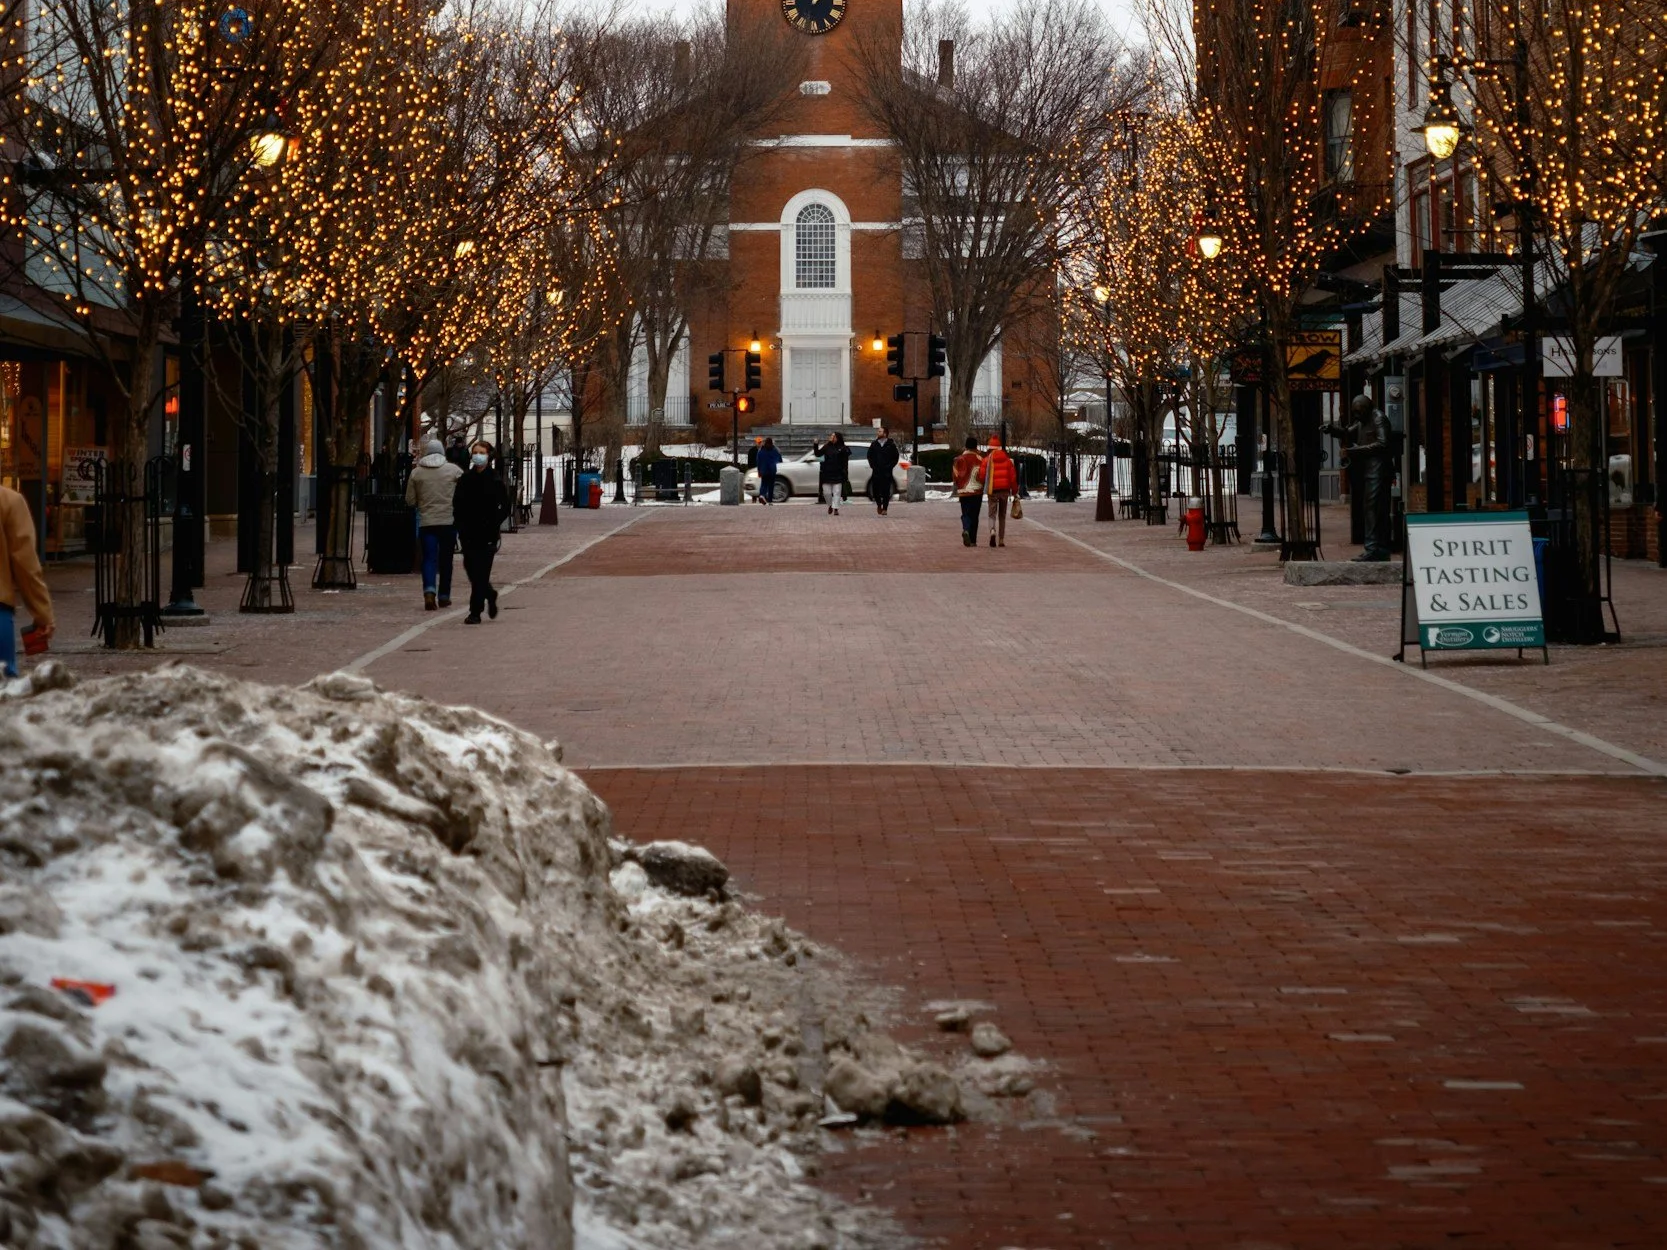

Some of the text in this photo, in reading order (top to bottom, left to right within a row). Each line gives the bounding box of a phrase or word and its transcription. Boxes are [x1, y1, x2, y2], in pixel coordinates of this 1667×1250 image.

[1289, 333, 1338, 343] ROW
[1551, 347, 1617, 357] HALSON'S
[1433, 539, 1512, 557] SPIRIT
[1420, 566, 1529, 585] TASTING
[1430, 593, 1528, 612] & SALES
